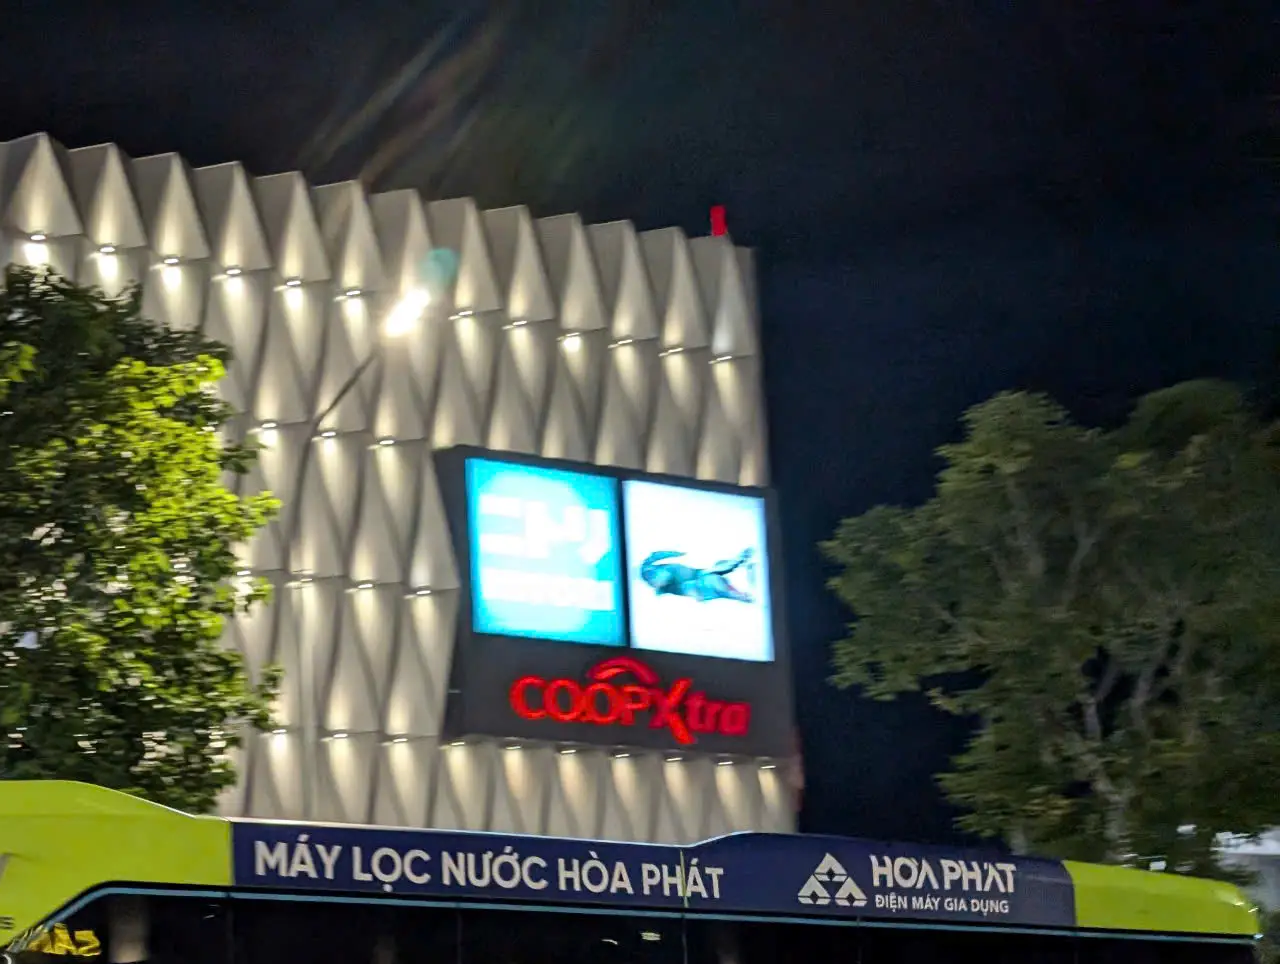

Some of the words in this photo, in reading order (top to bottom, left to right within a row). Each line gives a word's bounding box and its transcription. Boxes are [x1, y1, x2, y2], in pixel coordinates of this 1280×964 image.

[254, 833, 342, 879] MÁY
[352, 847, 431, 892] LỌC
[441, 845, 548, 890] NƯỚC
[558, 850, 634, 893] HÒA
[641, 857, 724, 898] PHÁT
[875, 892, 908, 912] ĐIỆN
[912, 893, 940, 911] MÁY
[944, 897, 967, 912] GIA
[971, 898, 1010, 916] DỤNG
